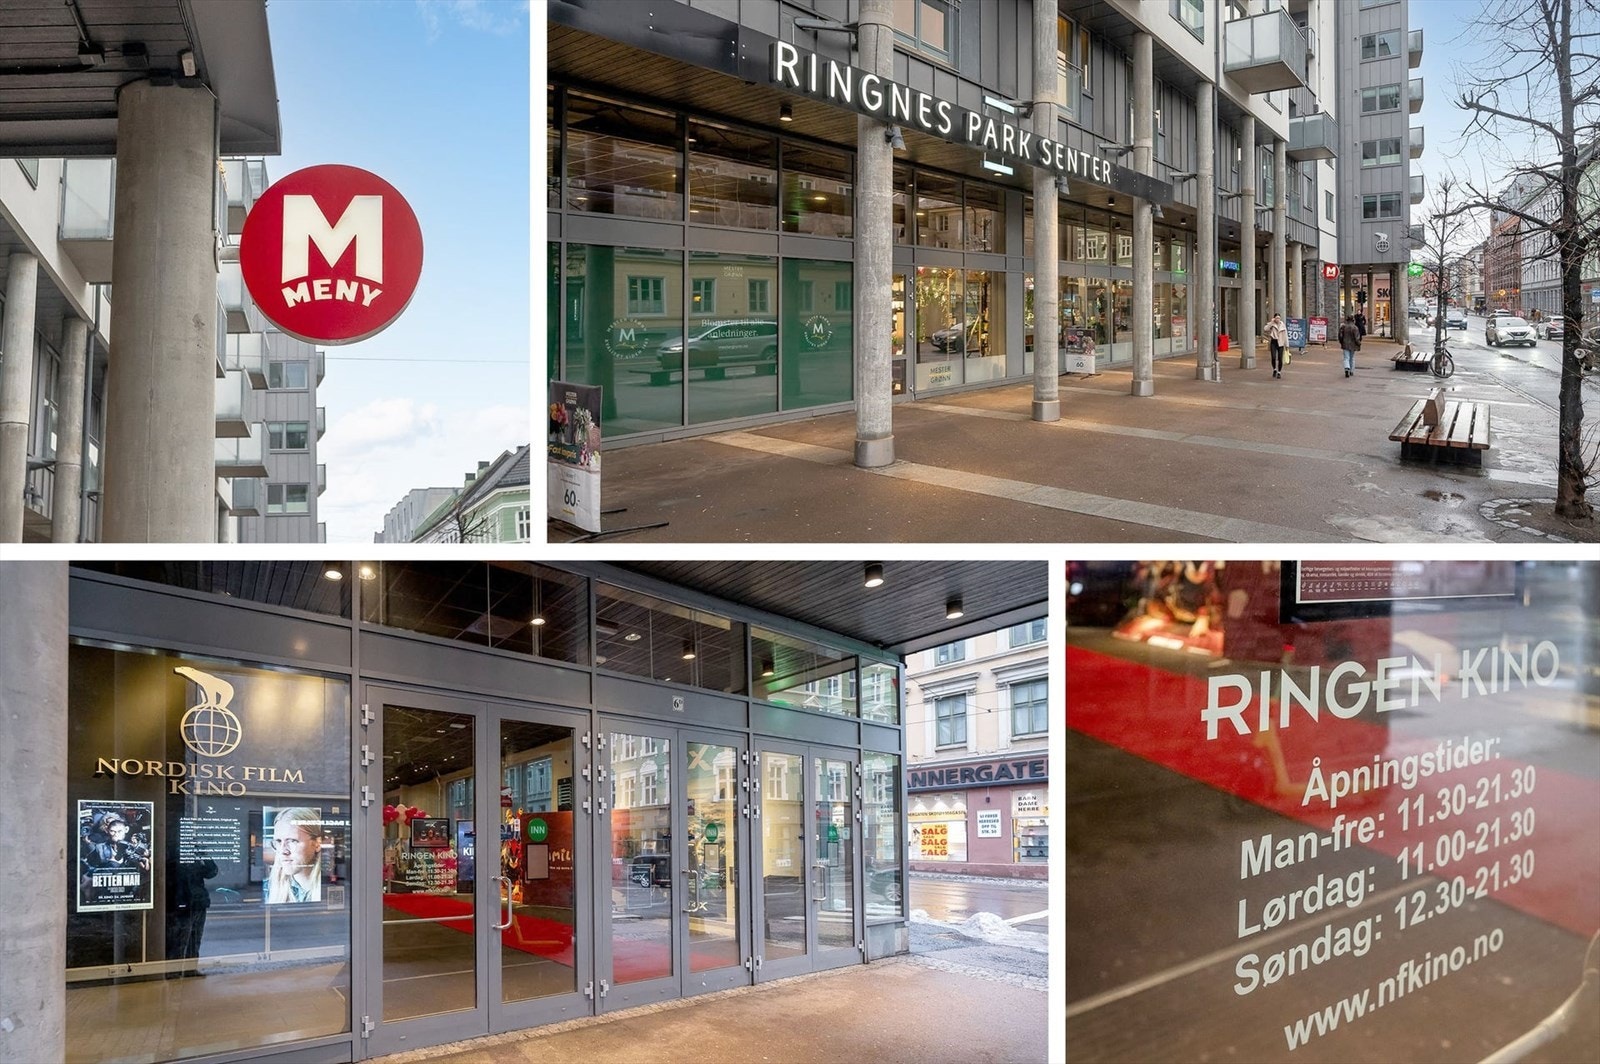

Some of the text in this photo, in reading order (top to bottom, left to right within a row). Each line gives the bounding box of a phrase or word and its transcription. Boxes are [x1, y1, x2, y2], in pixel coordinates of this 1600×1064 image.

[774, 40, 1112, 185] RINGNES PARK SENTER
[281, 194, 383, 285] M
[281, 278, 383, 308] MENY
[1377, 288, 1391, 298] SK
[619, 328, 635, 342] M
[708, 329, 759, 339] anledninger.
[812, 323, 824, 334] M
[930, 365, 952, 374] MESTER
[930, 375, 952, 384] GRØNN
[1201, 640, 1560, 740] RINGEN KINO
[95, 757, 306, 784] NORDISK FILM
[908, 759, 1049, 788] NNERGATE
[1302, 736, 1500, 809] Åpningstider:
[169, 779, 247, 797] KINO
[530, 826, 546, 835] INN
[1240, 765, 1536, 879] Man-fre: 11.30-21.30
[921, 828, 948, 836] SALG
[921, 838, 948, 846] SALG
[437, 851, 458, 859] KINO
[92, 874, 140, 887] BETTER MAN
[1238, 807, 1535, 939] Lørdag: 11.00-21.30
[1233, 849, 1535, 996] Søndag: 12.30-21.30
[1283, 928, 1504, 1051] www.nfkino.no
